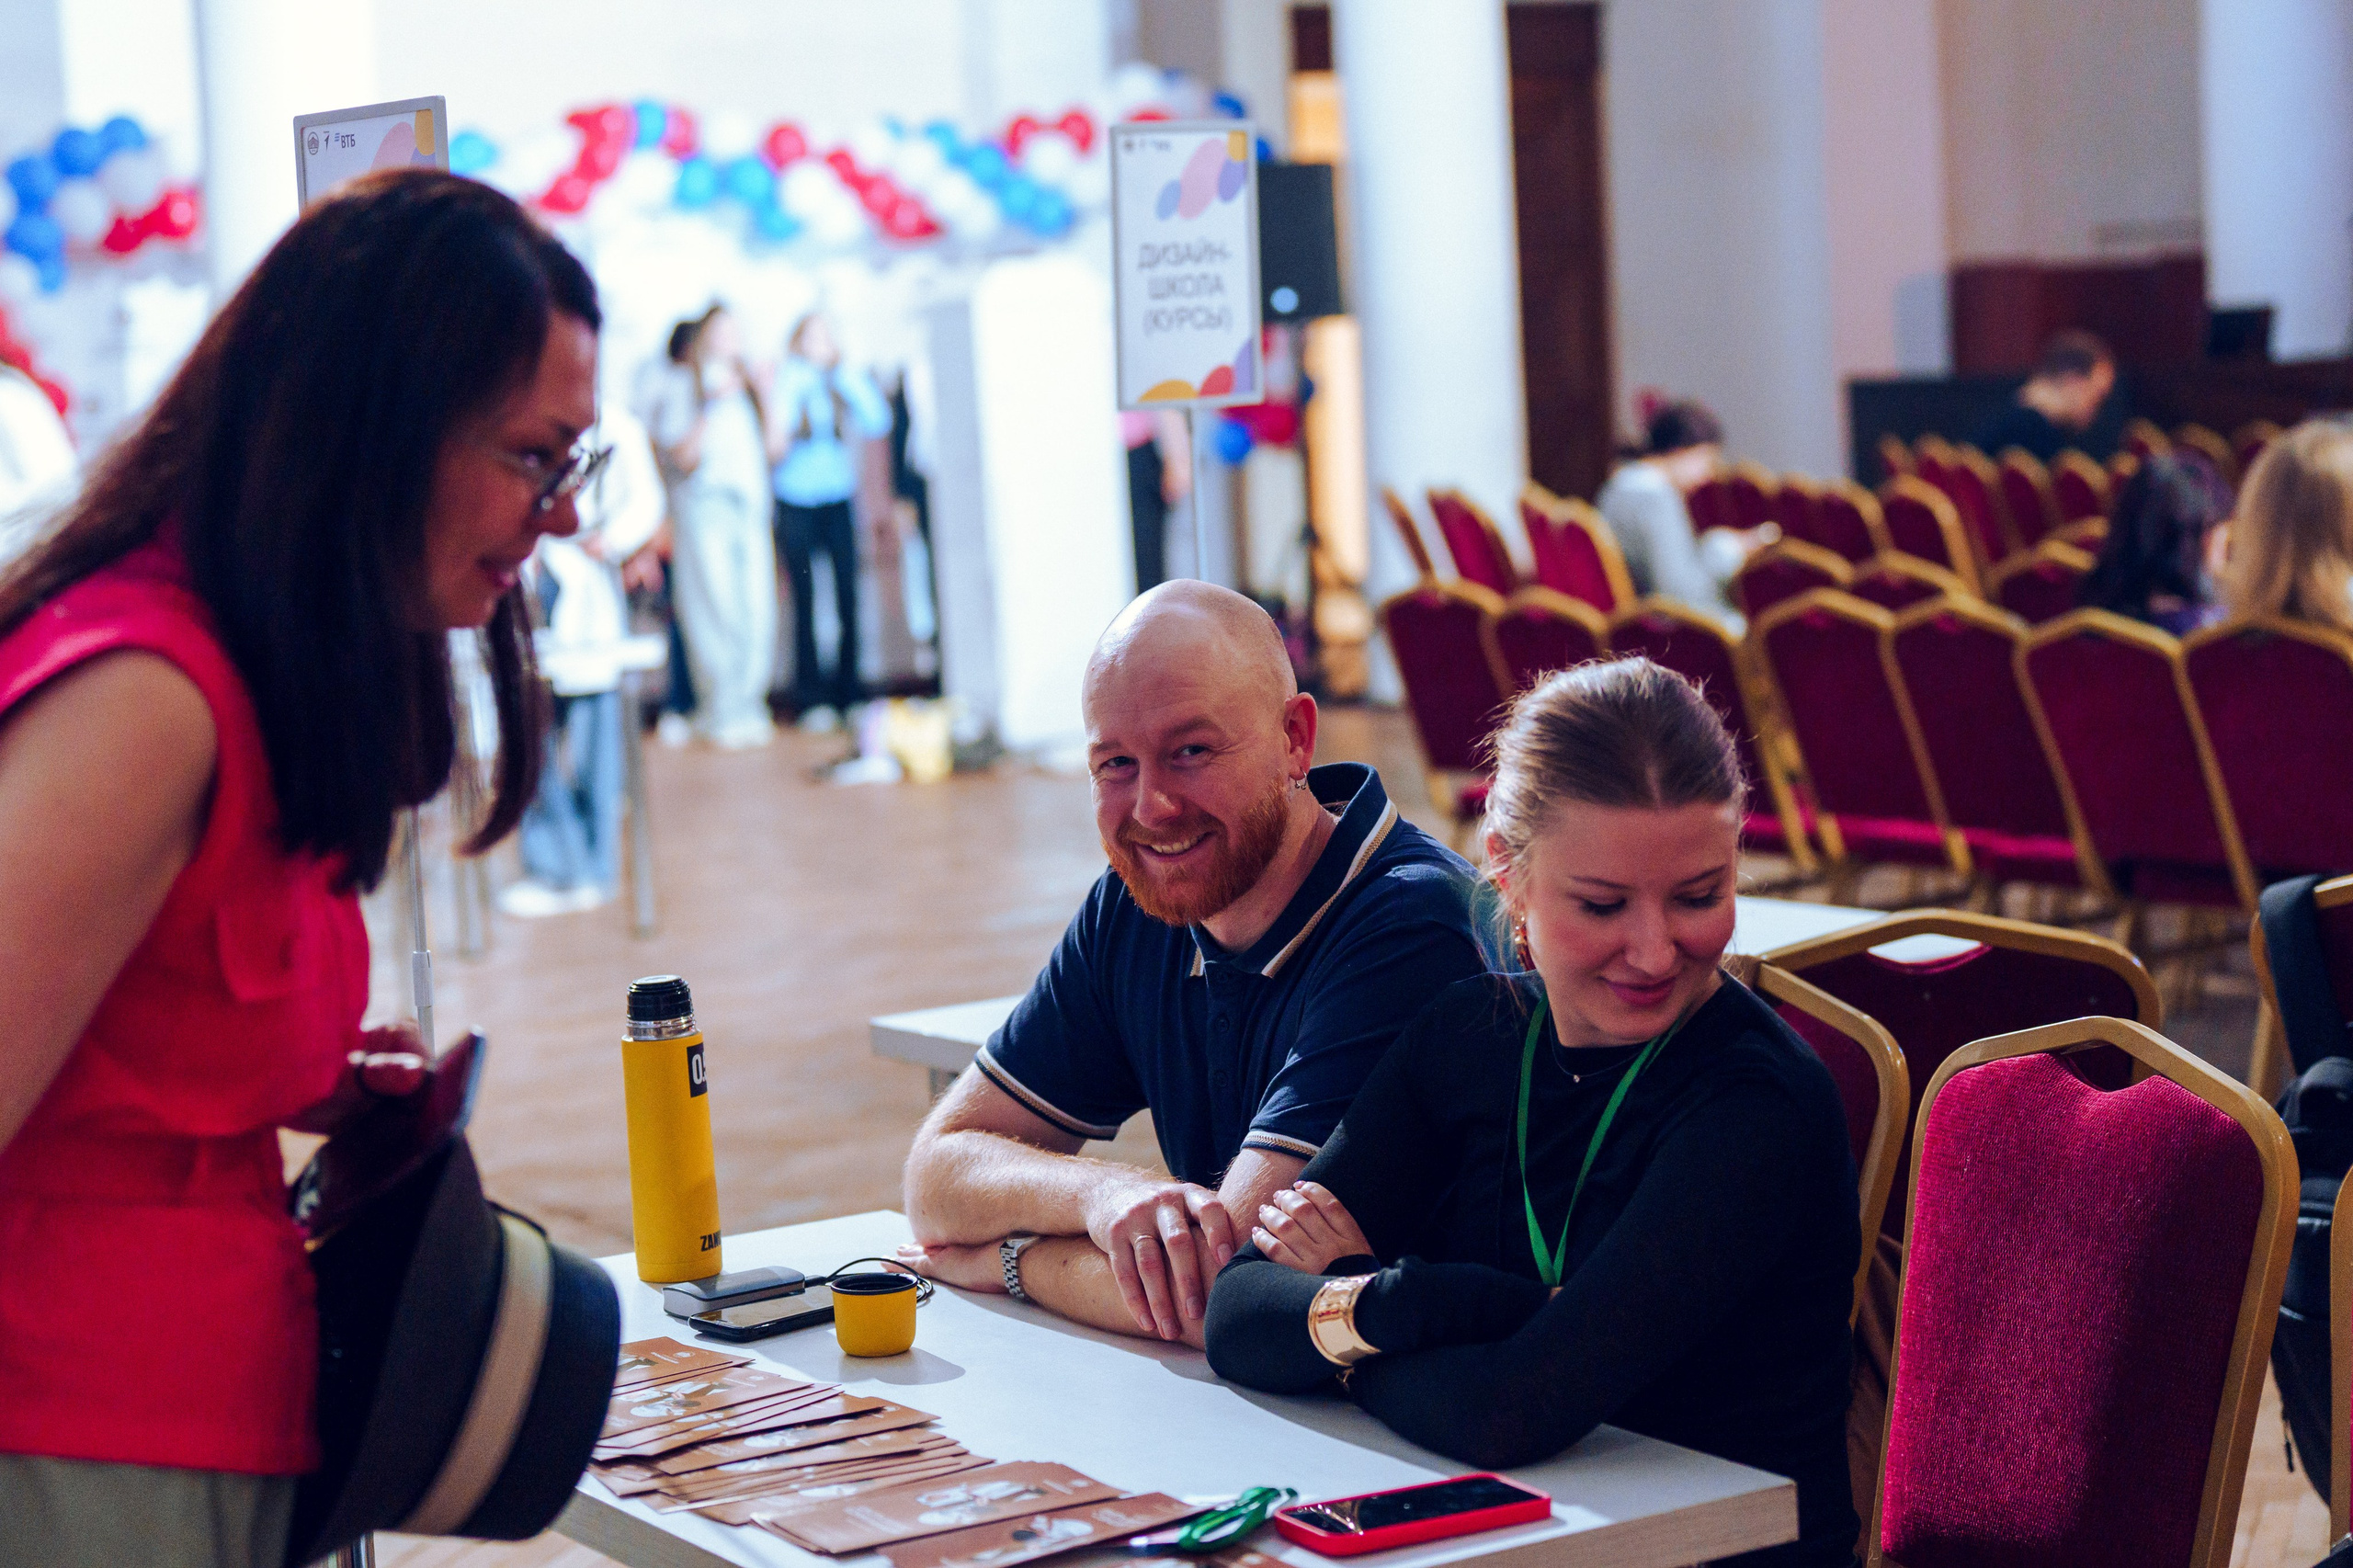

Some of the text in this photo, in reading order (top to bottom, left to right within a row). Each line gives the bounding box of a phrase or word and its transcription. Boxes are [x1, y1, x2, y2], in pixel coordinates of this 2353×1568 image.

[341, 134, 356, 148] ВТБ
[1139, 238, 1233, 268] ДИЗАЙН-
[1148, 274, 1225, 299] ШКОЛА
[1142, 306, 1233, 335] (КУРСЫ)
